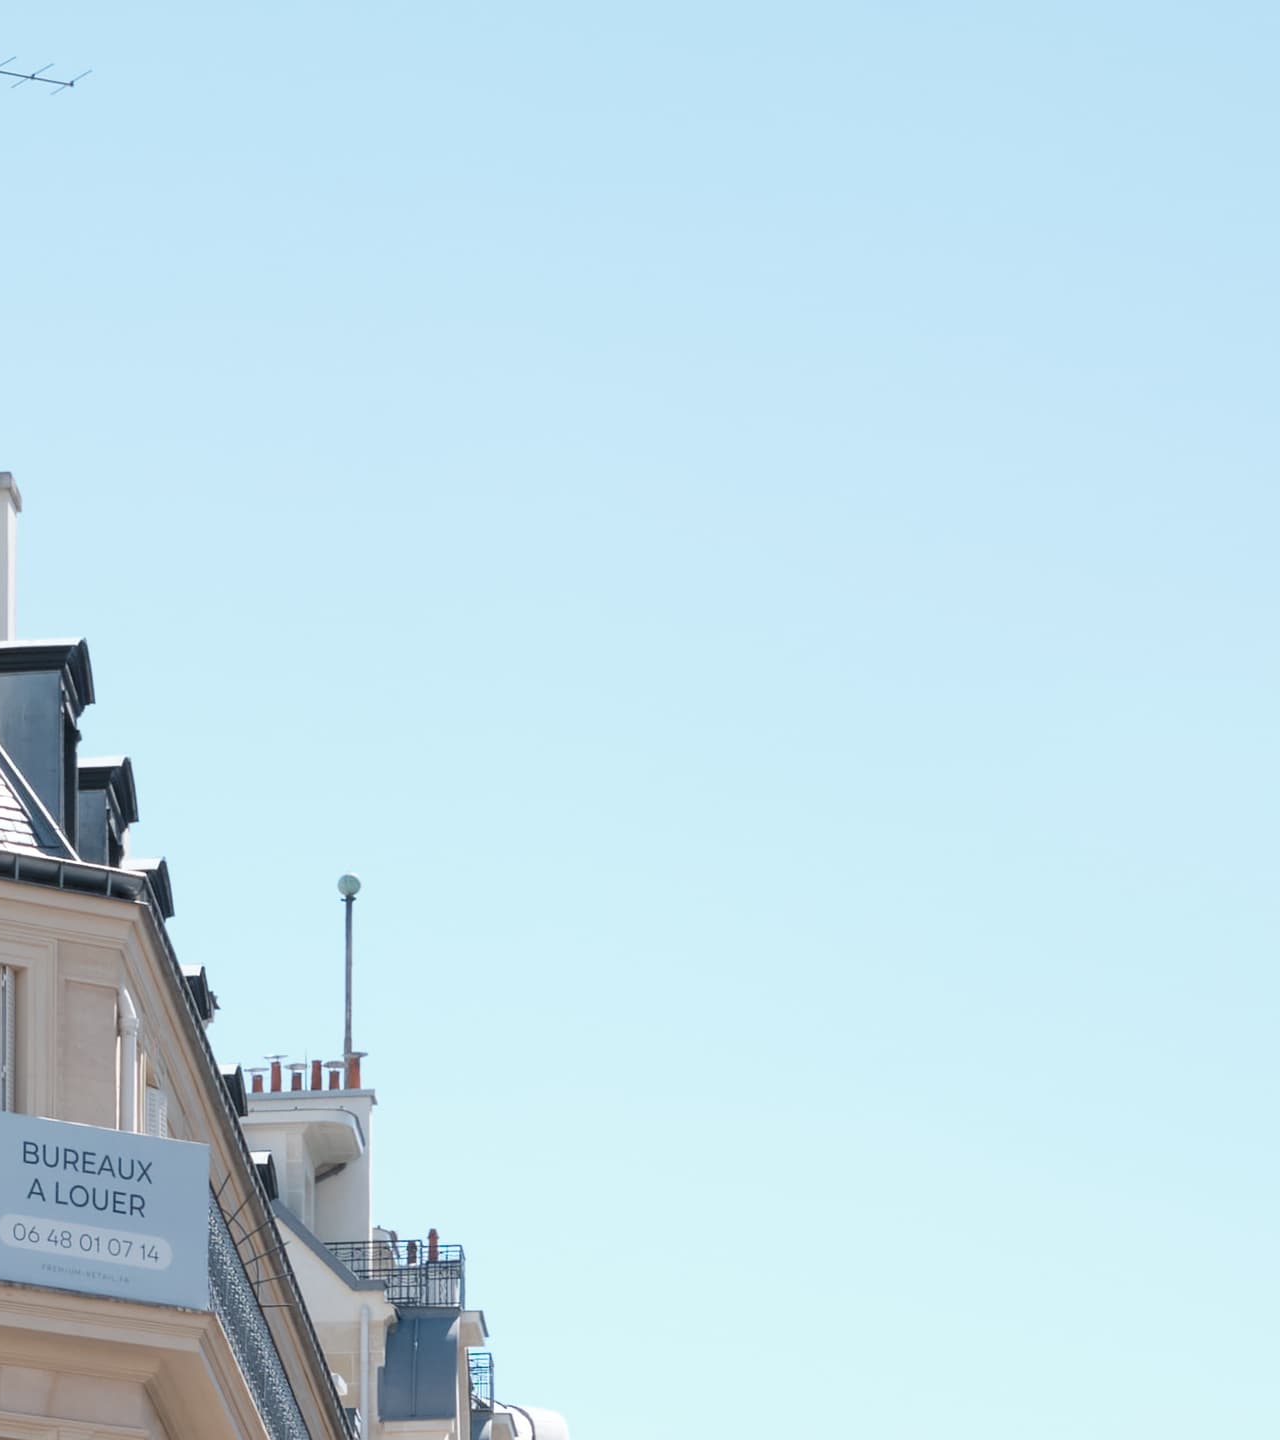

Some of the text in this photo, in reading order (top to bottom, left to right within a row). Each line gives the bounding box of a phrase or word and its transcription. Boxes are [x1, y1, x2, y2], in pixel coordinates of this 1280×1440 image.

[22, 1141, 153, 1185] BUREAUX
[27, 1178, 146, 1218] A LOUER
[12, 1222, 160, 1264] 06 48 01 07 14
